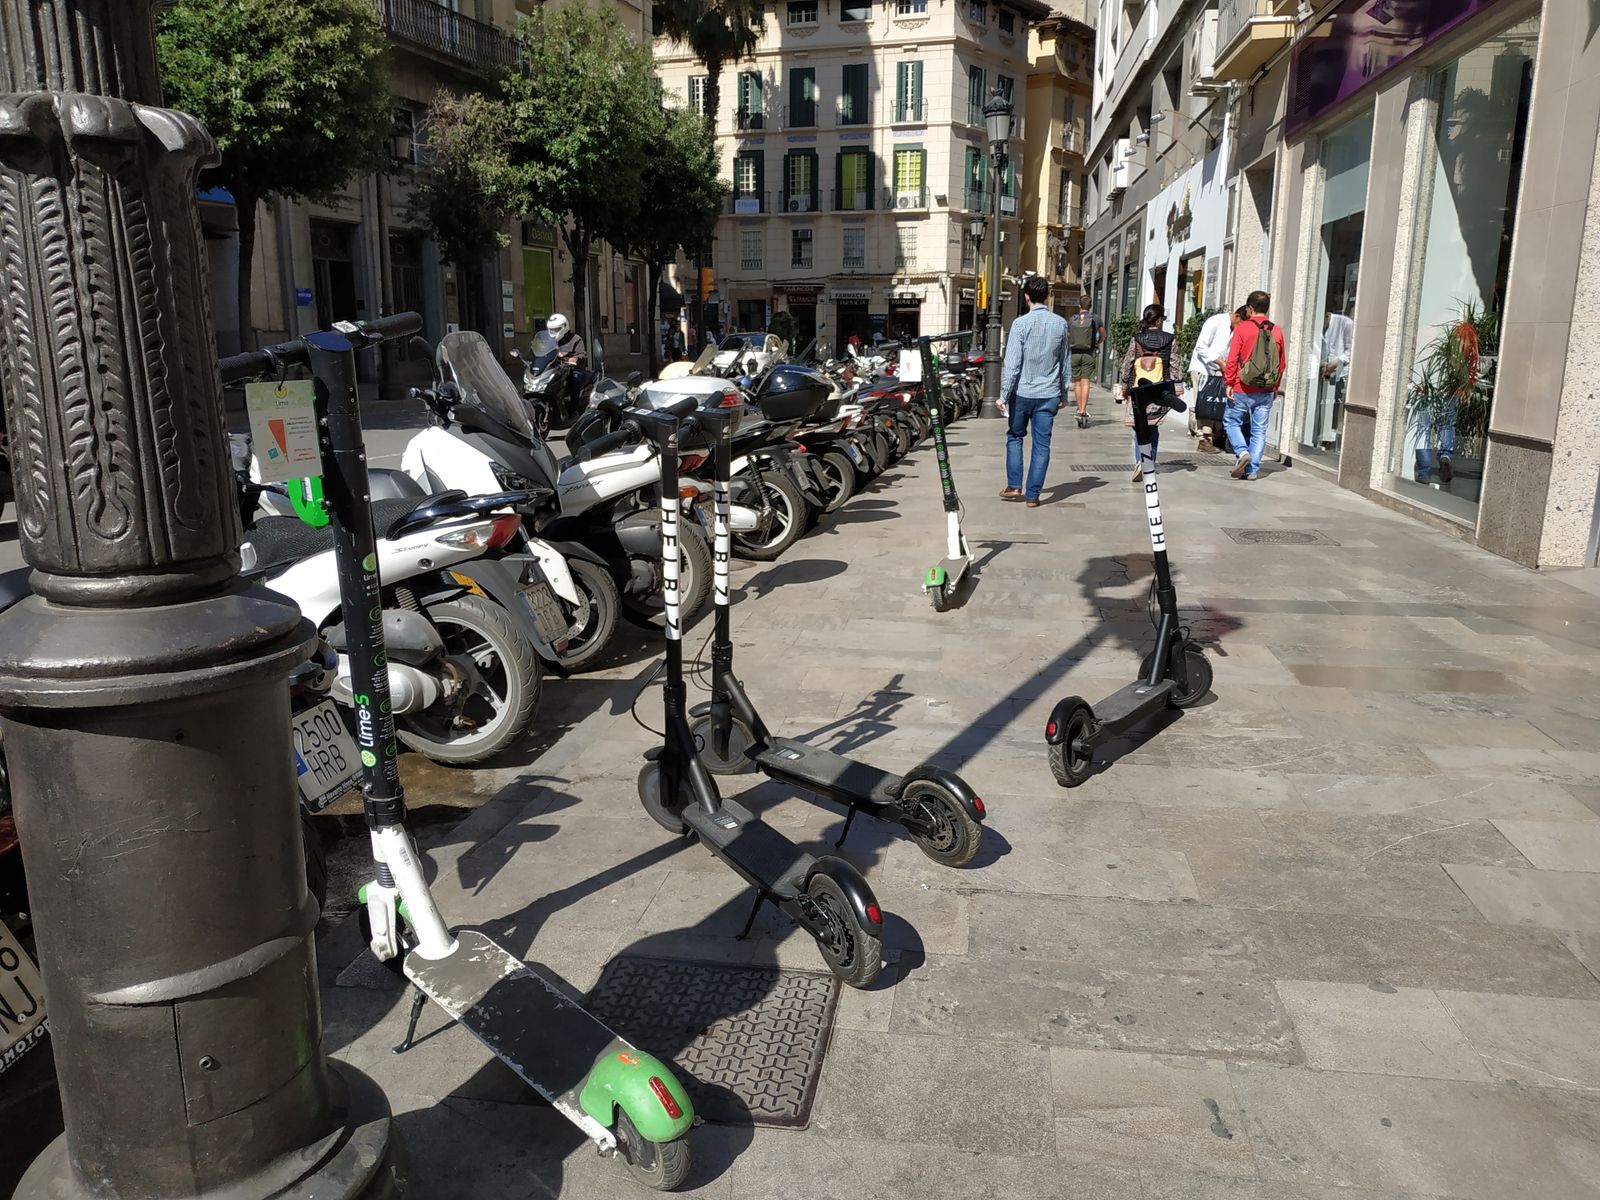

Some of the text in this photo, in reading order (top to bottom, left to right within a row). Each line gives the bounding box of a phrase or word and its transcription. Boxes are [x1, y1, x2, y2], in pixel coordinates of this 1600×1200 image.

[1141, 450, 1165, 545] HELBIZ
[293, 709, 341, 756] 2500
[306, 744, 347, 785] HRB
